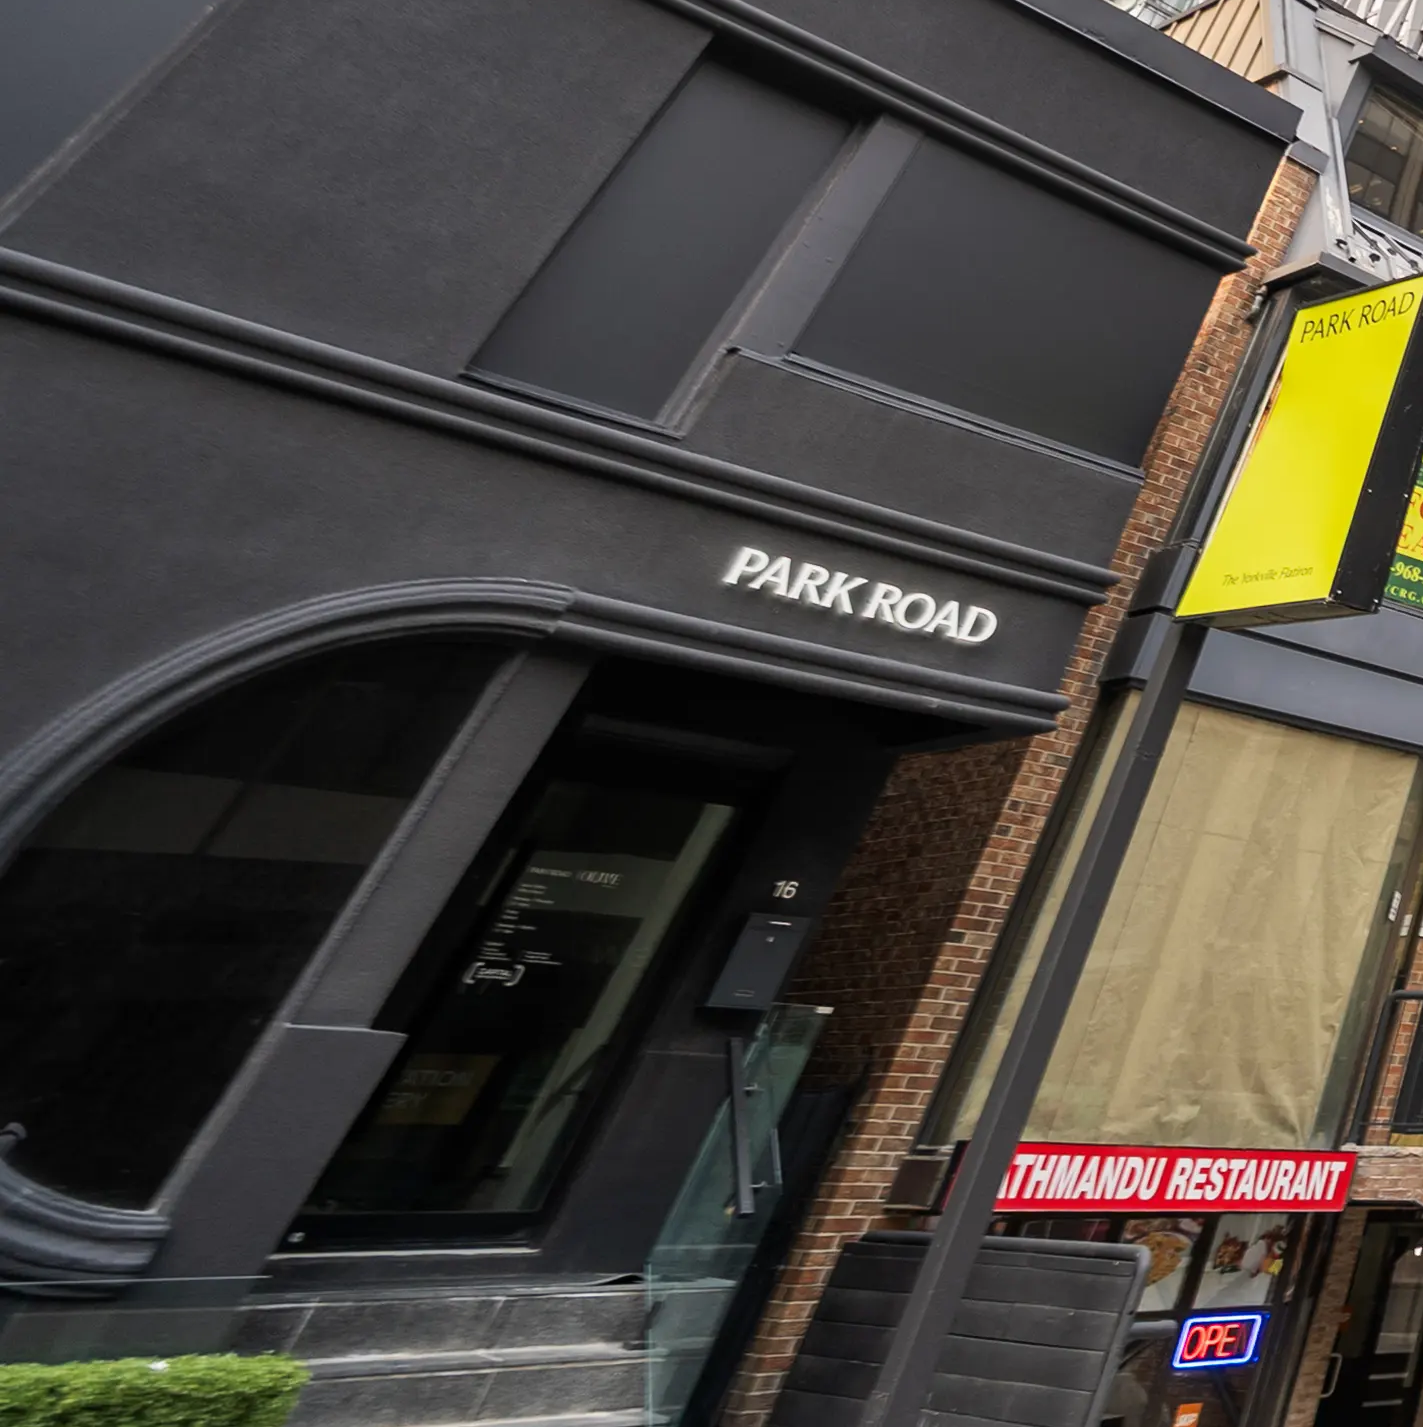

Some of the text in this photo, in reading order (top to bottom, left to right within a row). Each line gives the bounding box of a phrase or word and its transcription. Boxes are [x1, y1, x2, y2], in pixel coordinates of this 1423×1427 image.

[1300, 292, 1415, 343] PARK ROAD
[722, 546, 998, 643] PARK ROAD
[773, 880, 799, 899] 16
[997, 1154, 1347, 1200] THMANDU RESTAURANT
